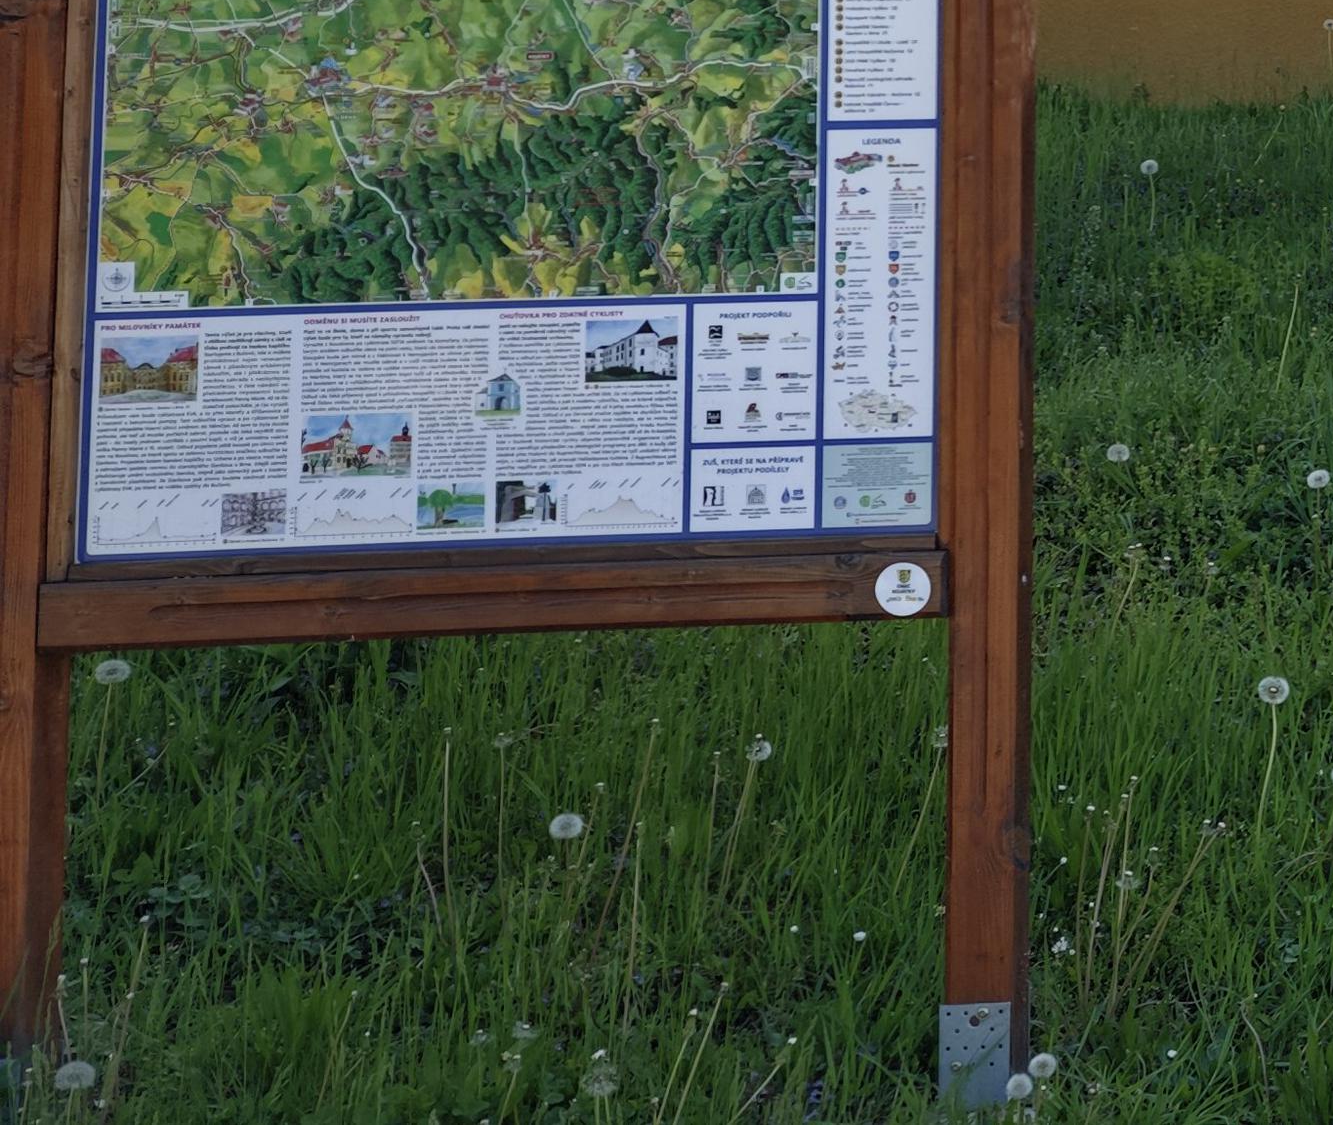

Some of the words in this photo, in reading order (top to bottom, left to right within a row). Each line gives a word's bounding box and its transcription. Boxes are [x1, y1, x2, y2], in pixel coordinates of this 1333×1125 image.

[861, 137, 902, 146] LEGENDA
[541, 311, 557, 319] PRO
[559, 309, 588, 318] ZDATNÉ
[589, 310, 624, 318] CYKLISTY
[719, 312, 750, 320] PROJEKT
[752, 310, 792, 319] PODPOŘILI
[303, 317, 339, 326] ODMĚNU
[349, 315, 378, 324] MUSÍTE
[380, 314, 421, 323] ZASLOUŽIT
[118, 322, 164, 332] MILOVNÍKY
[165, 321, 202, 330] PAMÁTEK
[721, 456, 743, 465] KTERÉ
[745, 457, 753, 465] SE
[717, 467, 753, 476] PROJEKTU
